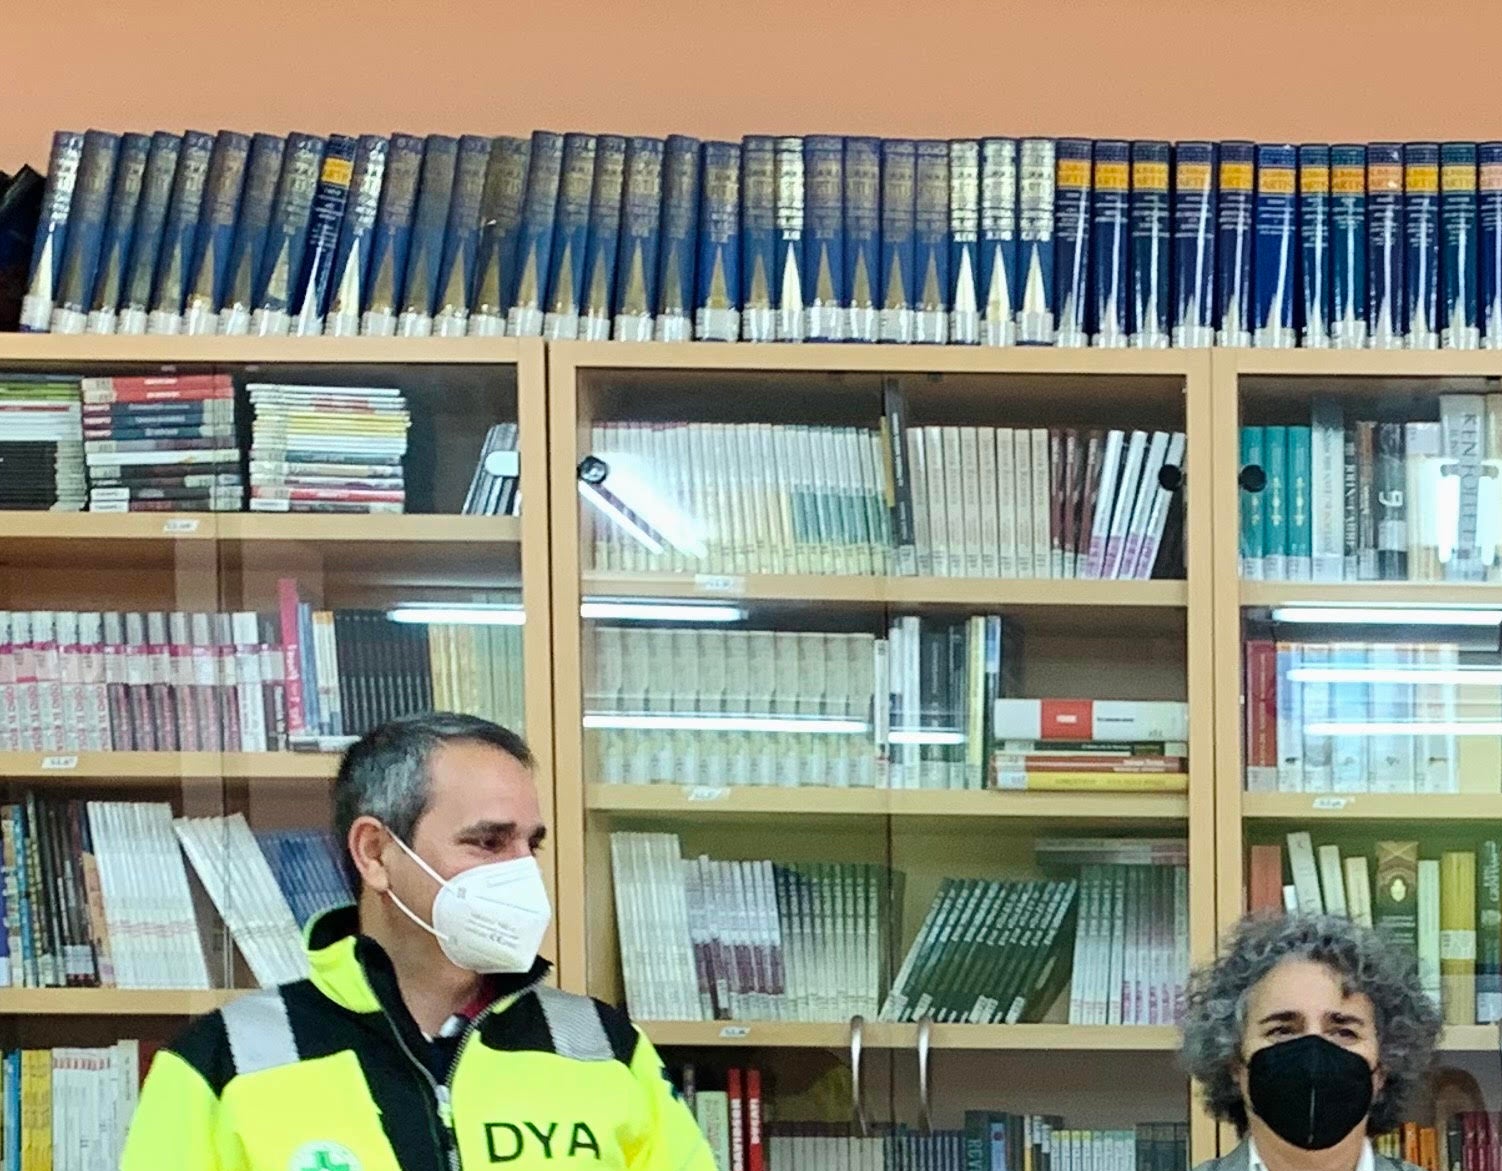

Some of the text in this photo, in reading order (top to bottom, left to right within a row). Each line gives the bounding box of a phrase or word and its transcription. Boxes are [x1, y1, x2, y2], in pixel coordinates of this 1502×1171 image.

[1461, 413, 1477, 458] KEN
[483, 1121, 602, 1164] DYA
[731, 1099, 743, 1171] DAVIDSON
